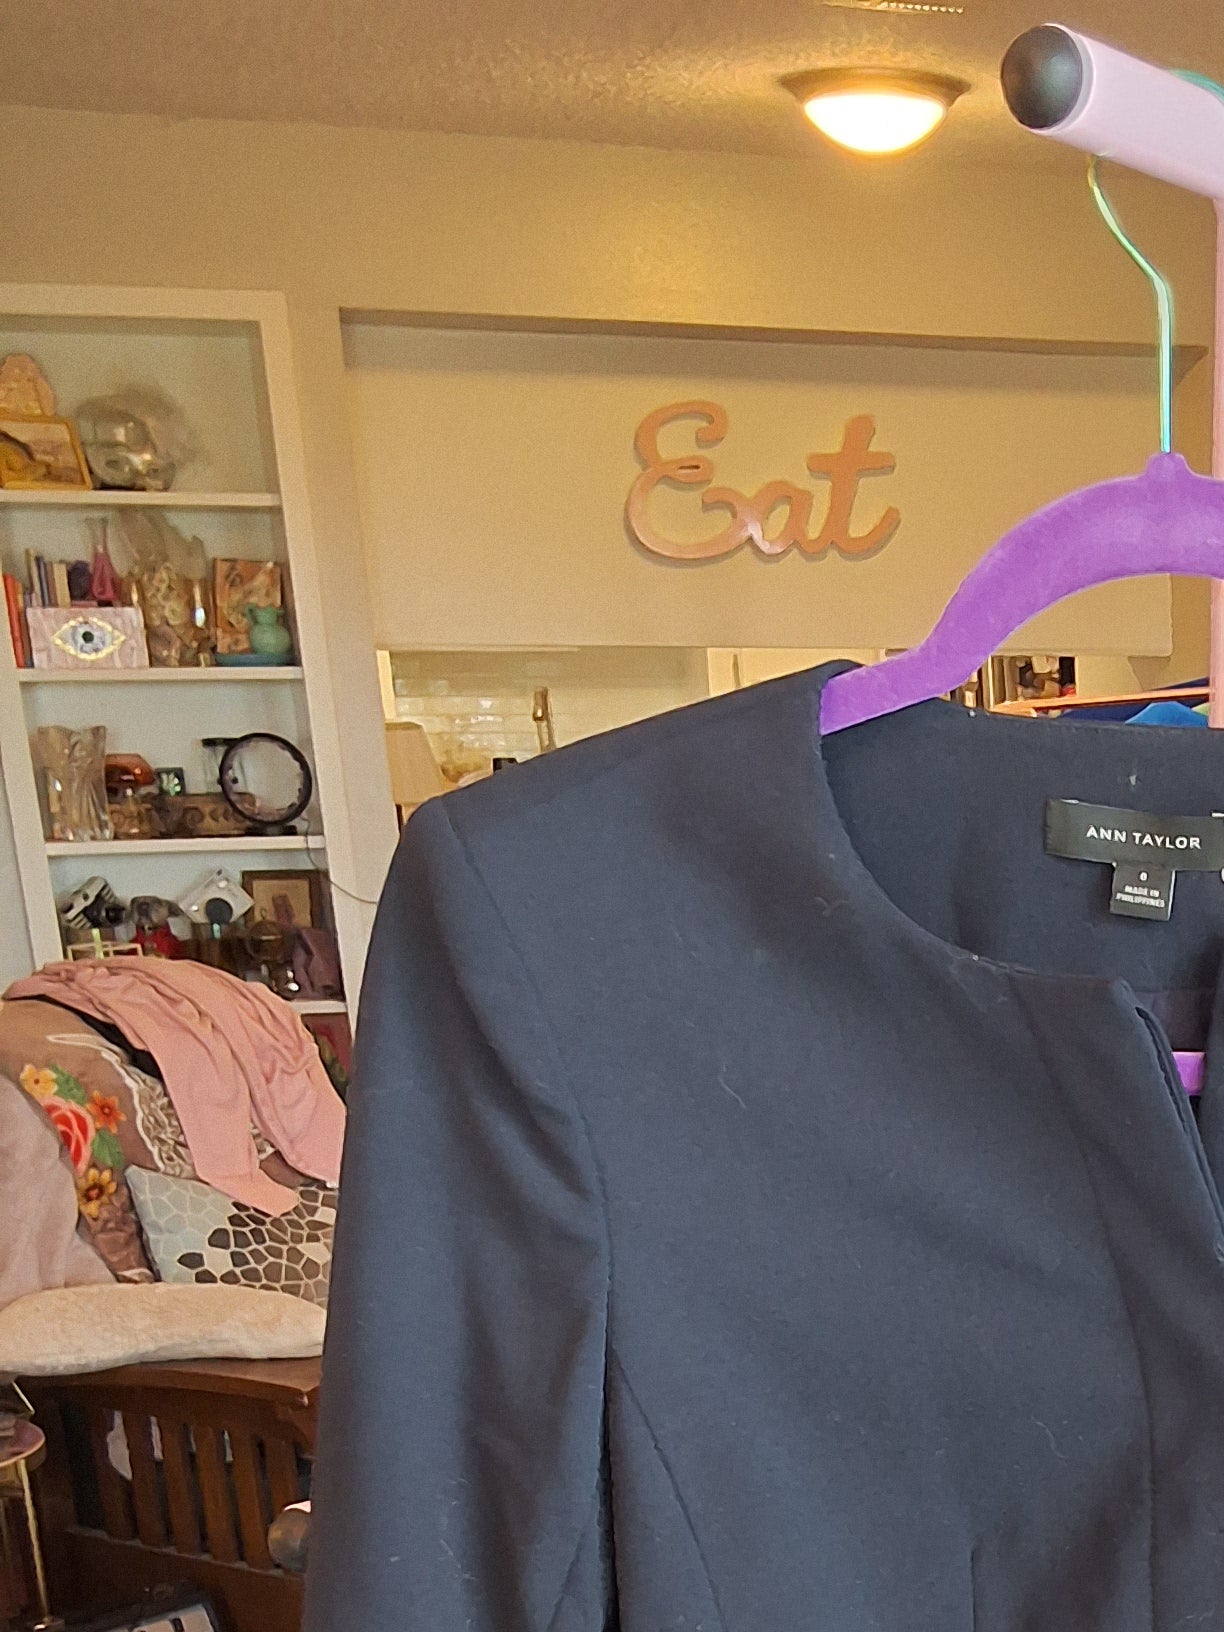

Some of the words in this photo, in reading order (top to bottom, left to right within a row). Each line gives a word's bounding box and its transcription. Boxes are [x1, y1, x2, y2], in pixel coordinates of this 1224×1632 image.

[626, 400, 900, 564] Eat
[1086, 824, 1127, 843] ANN
[1132, 831, 1201, 850] TAYLOR
[1124, 885, 1149, 896] MADE
